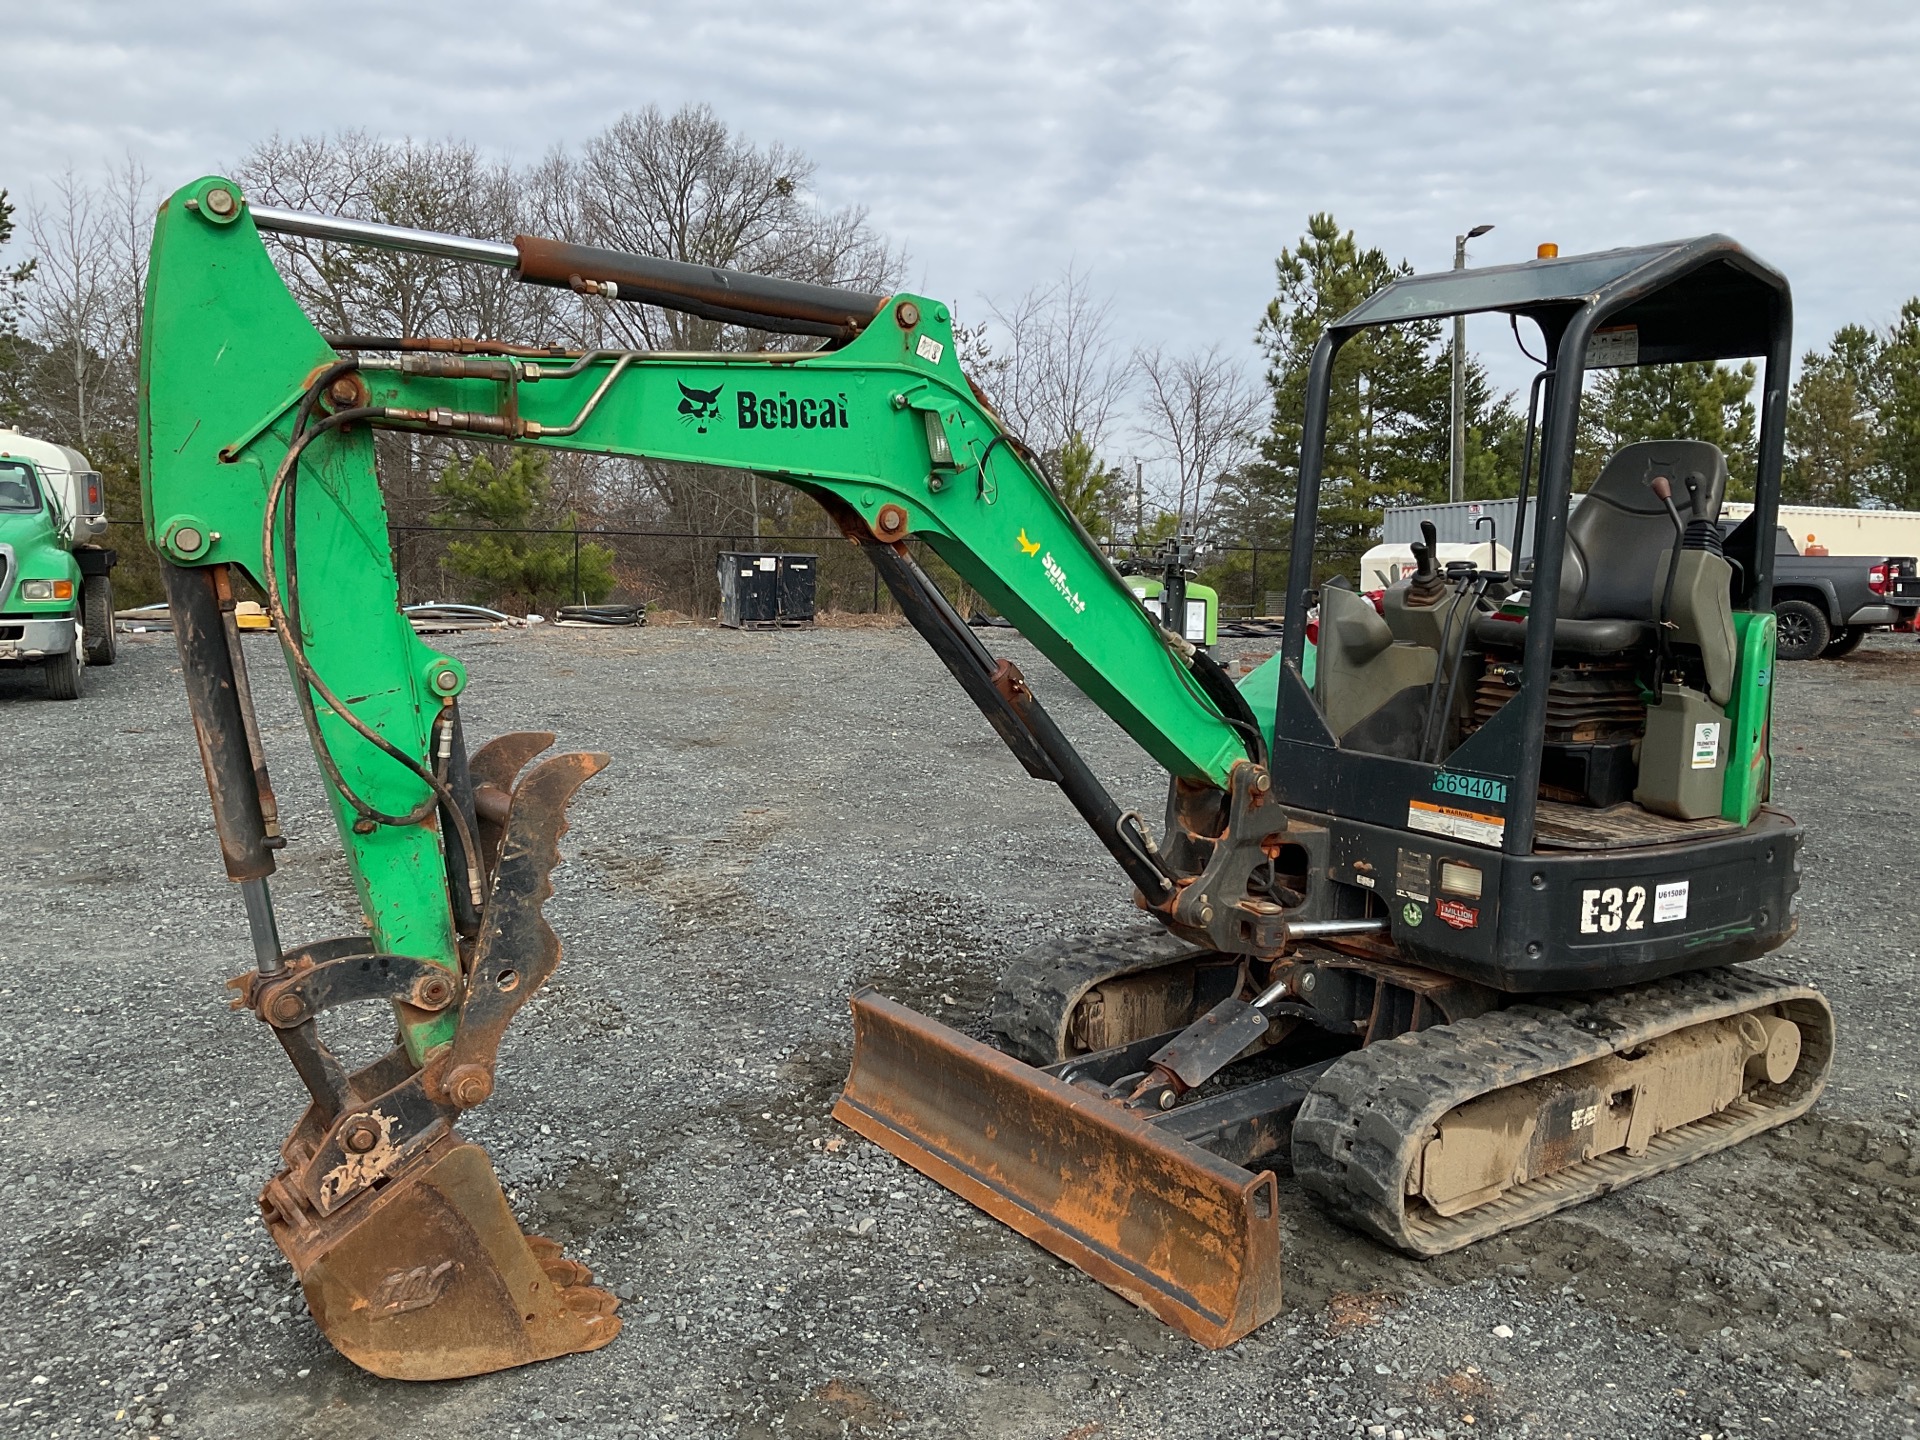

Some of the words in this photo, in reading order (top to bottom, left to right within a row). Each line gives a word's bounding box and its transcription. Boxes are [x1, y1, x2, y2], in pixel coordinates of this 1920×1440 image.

[736, 391, 849, 429] Bobcat
[1044, 570, 1081, 614] RENTALS
[1435, 774, 1503, 801] 669401
[1445, 808, 1474, 819] WARNING
[1658, 888, 1687, 899] U615089
[1445, 906, 1473, 920] MILLION
[1580, 886, 1646, 933] E32
